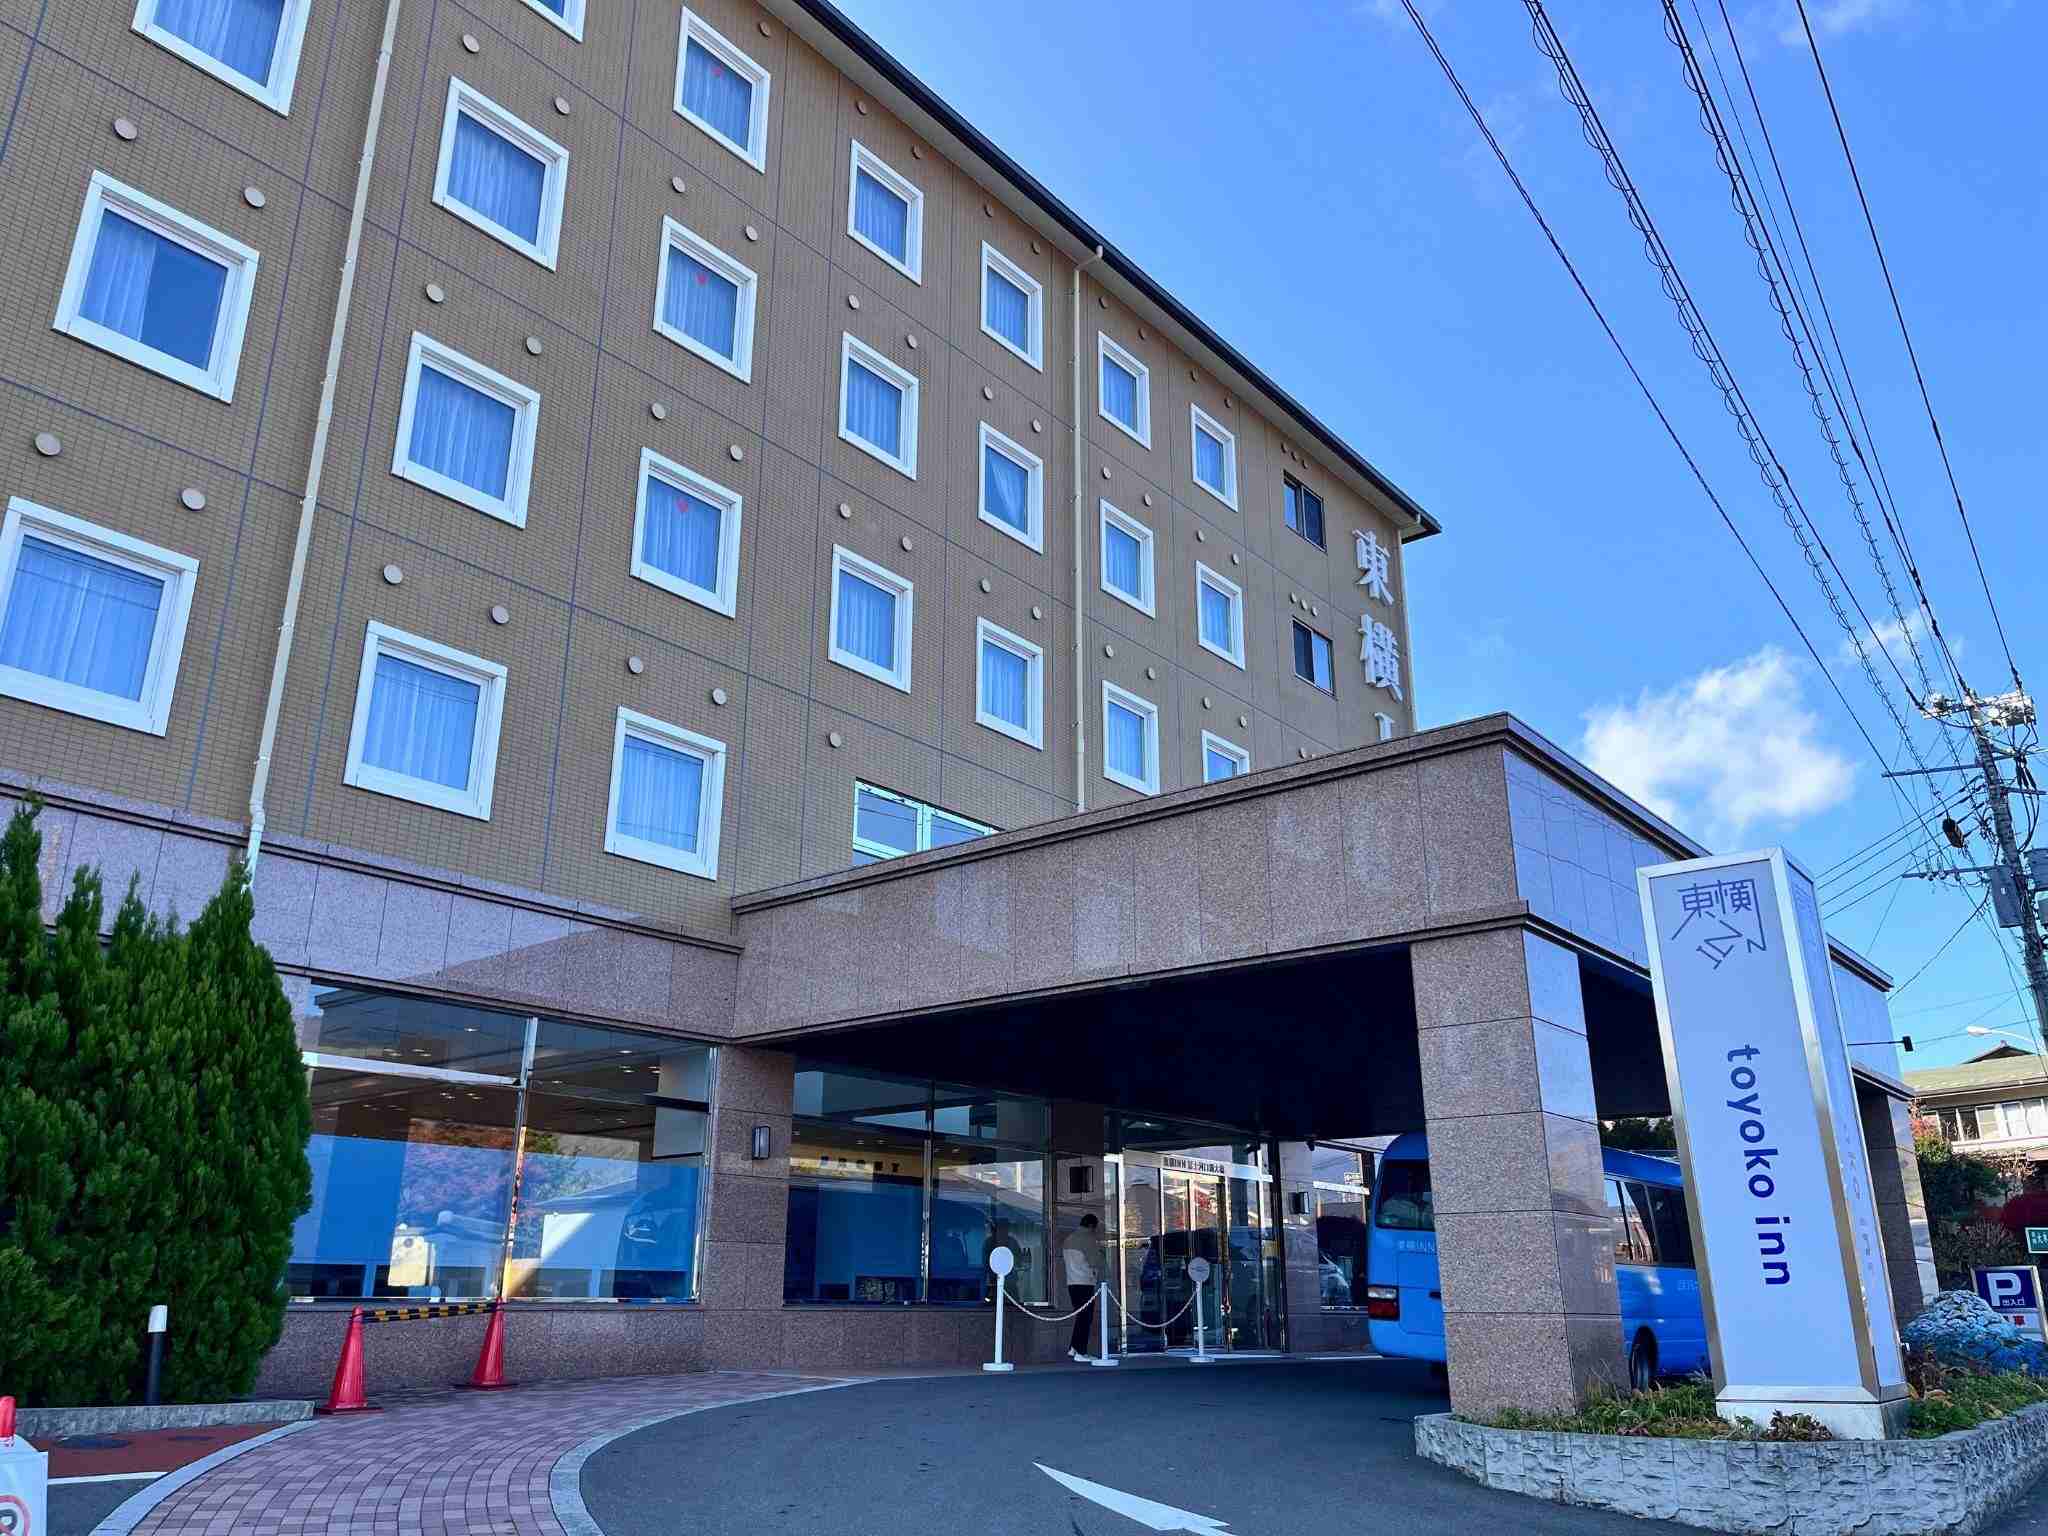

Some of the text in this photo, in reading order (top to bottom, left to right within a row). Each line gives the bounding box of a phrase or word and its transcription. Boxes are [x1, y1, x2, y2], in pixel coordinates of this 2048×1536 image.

[1726, 1044, 1791, 1285] toyoko inn
[1986, 1272, 2022, 1307] P
